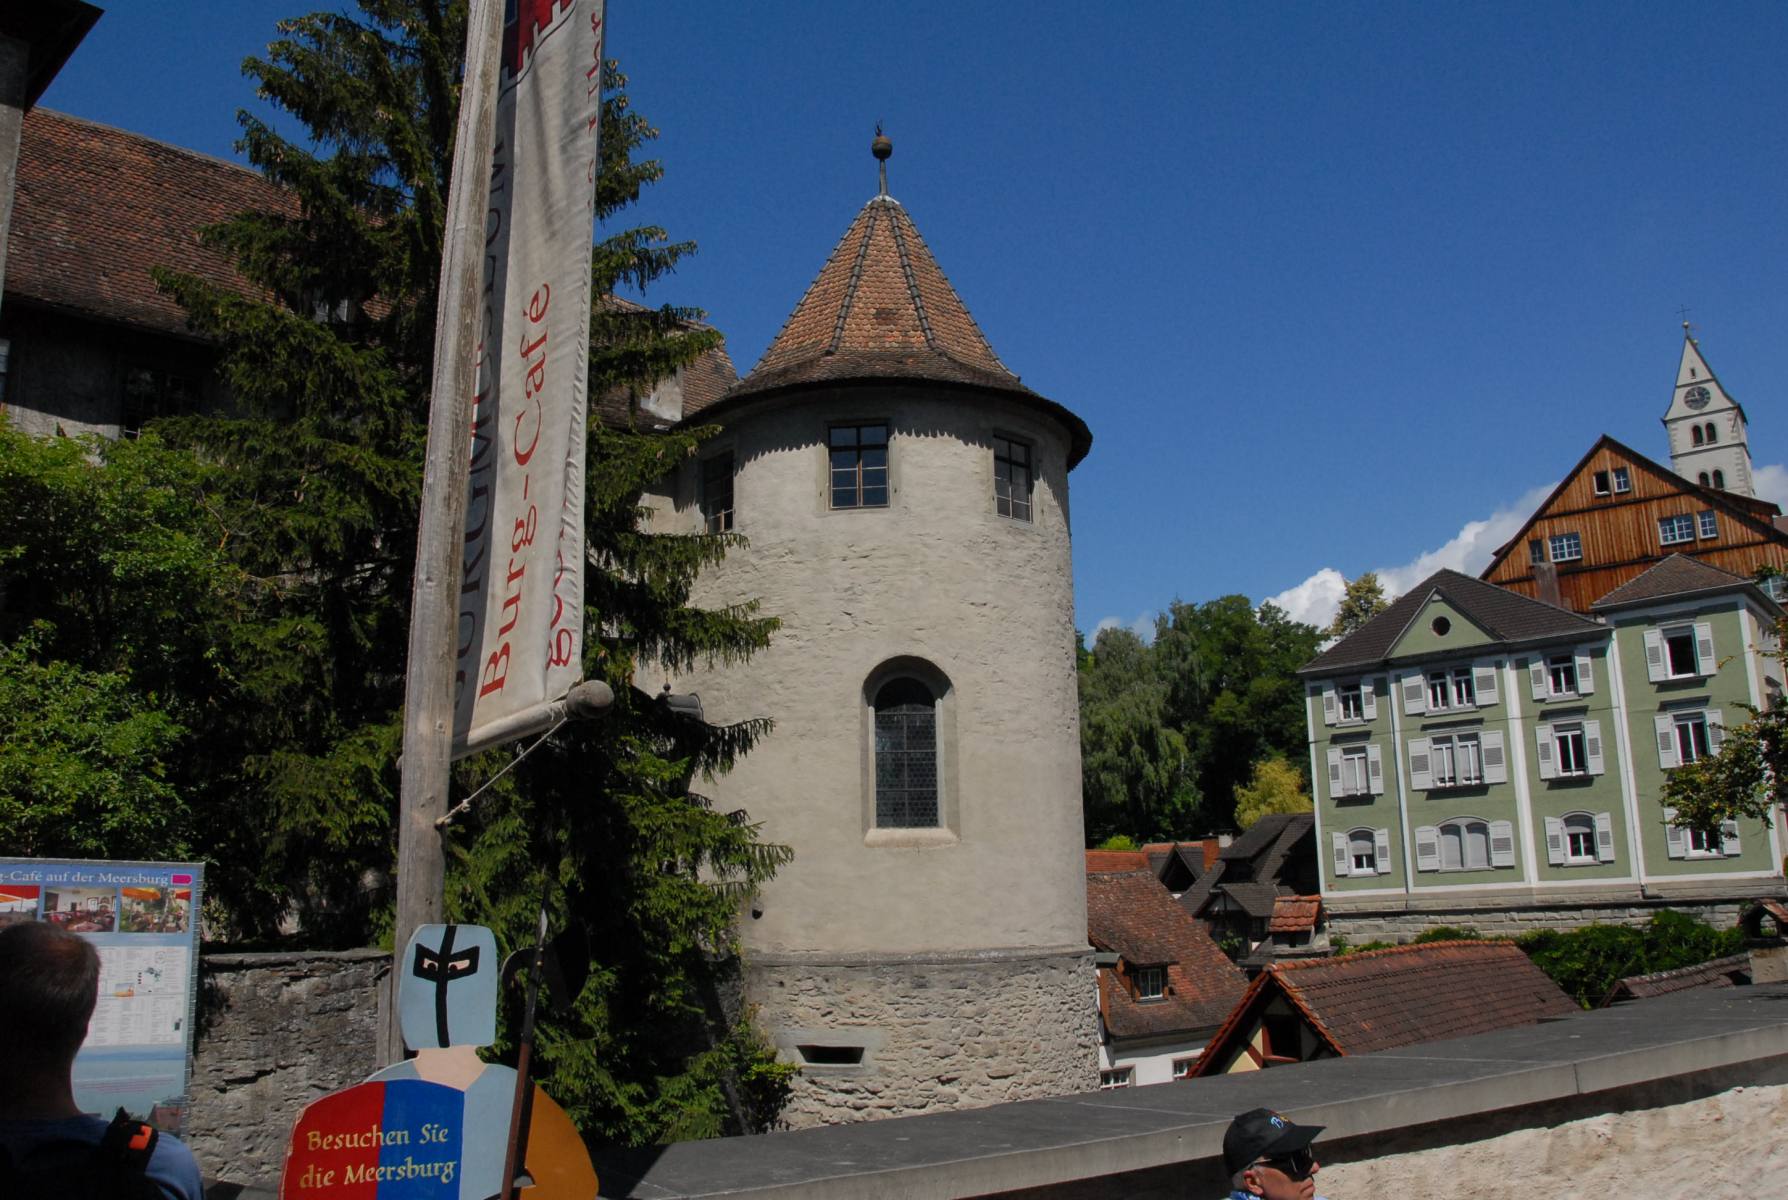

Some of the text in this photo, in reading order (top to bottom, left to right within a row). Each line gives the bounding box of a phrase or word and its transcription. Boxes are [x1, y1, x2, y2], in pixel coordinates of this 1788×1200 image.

[478, 283, 550, 700] Burg-Café
[46, 871, 70, 882] auf
[71, 871, 95, 882] der
[98, 872, 169, 888] Meersburg
[306, 1123, 449, 1151] Besuchen Sie
[299, 1156, 457, 1189] die Meersburg
